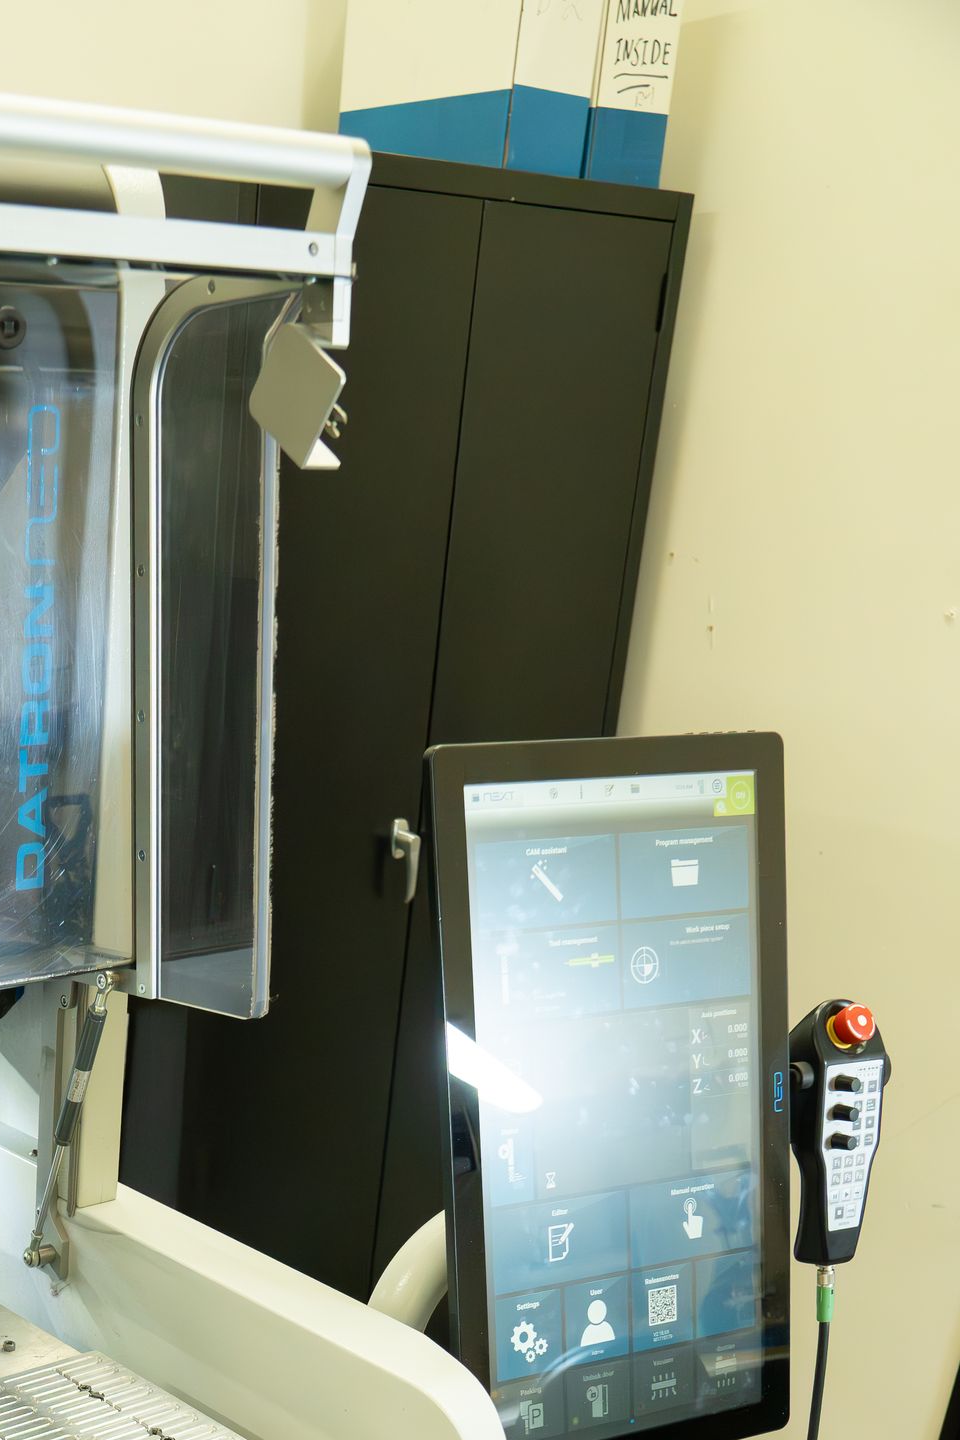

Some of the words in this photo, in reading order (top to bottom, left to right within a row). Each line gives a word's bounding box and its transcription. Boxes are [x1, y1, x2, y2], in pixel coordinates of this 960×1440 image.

[616, 0, 677, 23] MANUAL
[615, 38, 671, 66] INSIDE
[15, 585, 56, 892] DATRON
[691, 1028, 702, 1044] X
[727, 1023, 748, 1034] 0.000
[692, 1053, 702, 1069] Y
[728, 1047, 748, 1058] 0.000
[693, 1078, 702, 1095] Z
[728, 1072, 748, 1083] 0.000
[589, 1288, 604, 1296] User
[516, 1301, 540, 1311] Settings
